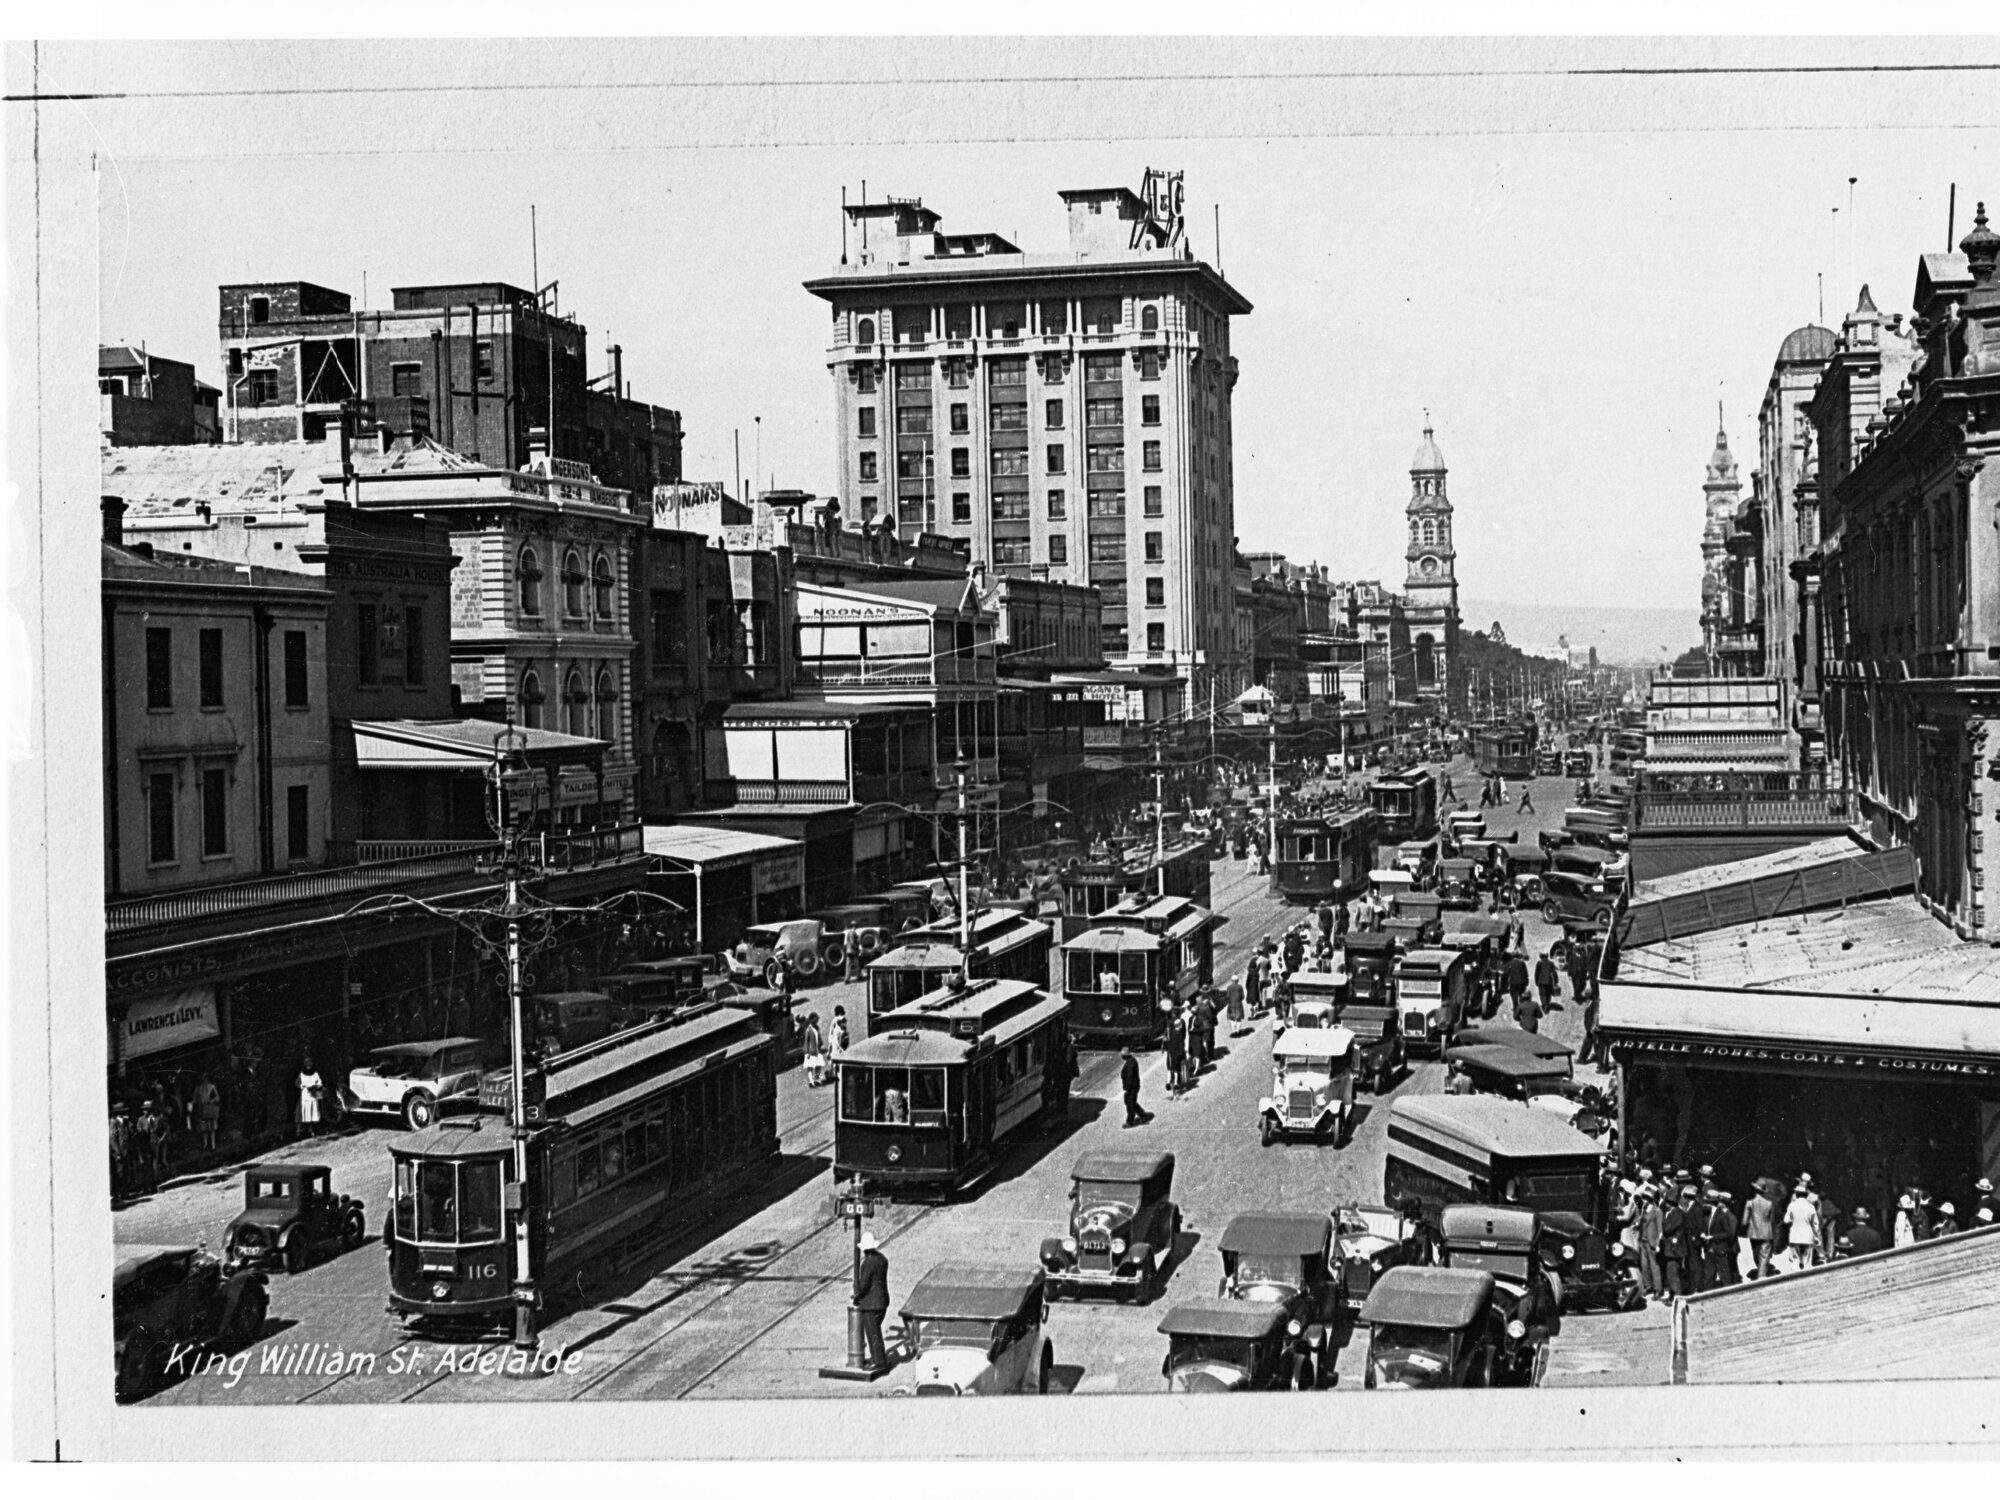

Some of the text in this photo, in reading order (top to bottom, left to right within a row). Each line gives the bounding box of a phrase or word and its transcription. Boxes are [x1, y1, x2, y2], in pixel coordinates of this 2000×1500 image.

[333, 560, 444, 582] THE AUSTRALIA HOUSE
[565, 782, 599, 793] TAILORS
[1121, 1006, 1138, 1016] 30
[129, 1013, 175, 1036] LAWRENCE
[960, 1020, 973, 1033] 6
[1780, 1051, 1844, 1064] COATS
[526, 1105, 539, 1120] 3
[846, 1203, 864, 1214] GO
[468, 1263, 497, 1280] 116
